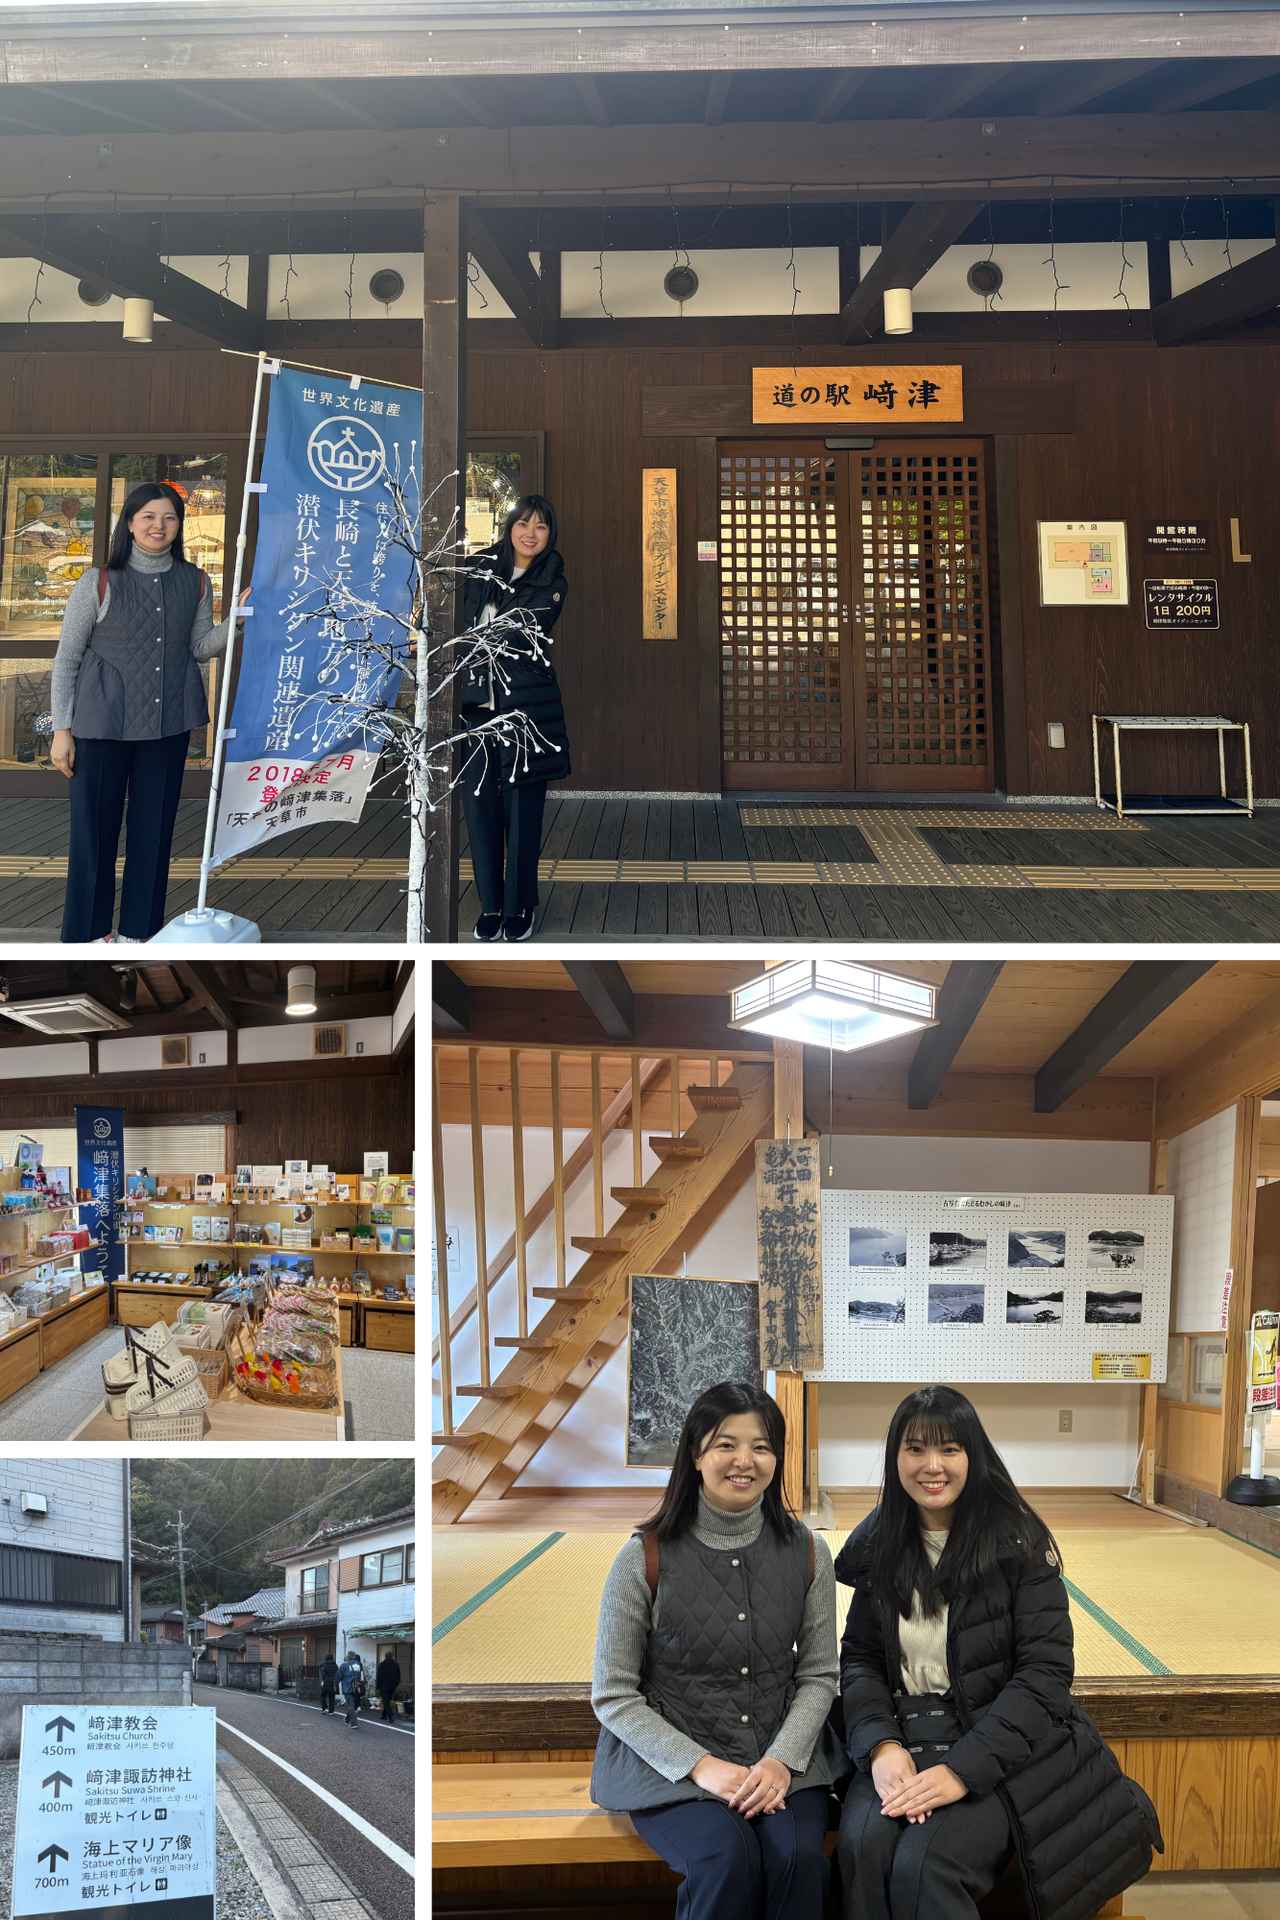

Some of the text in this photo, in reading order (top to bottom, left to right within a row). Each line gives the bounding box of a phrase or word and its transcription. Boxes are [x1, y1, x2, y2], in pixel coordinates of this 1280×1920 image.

[301, 387, 400, 417] 世界文化遺産
[773, 383, 853, 408] 道の駅
[1149, 593, 1213, 603] レンタサイクル
[1153, 605, 1211, 616] 1日 200円
[263, 493, 321, 751] 潜伏キリシタン関連遺産
[226, 790, 353, 828] 「天の﨑津集落」
[265, 806, 308, 832] 天草市
[88, 1731, 154, 1740] Sakitsu Church
[42, 1746, 76, 1756] 450m
[85, 1785, 176, 1796] Sakitsu Suwa Shrine
[38, 1802, 73, 1813] 400m
[84, 1810, 151, 1825] 観光トイレ
[83, 1834, 192, 1858] 海上マリア像
[82, 1852, 193, 1869] Statue of the Virgin Mary
[34, 1877, 69, 1889] 700m
[81, 1882, 151, 1899] 観光トイレ
